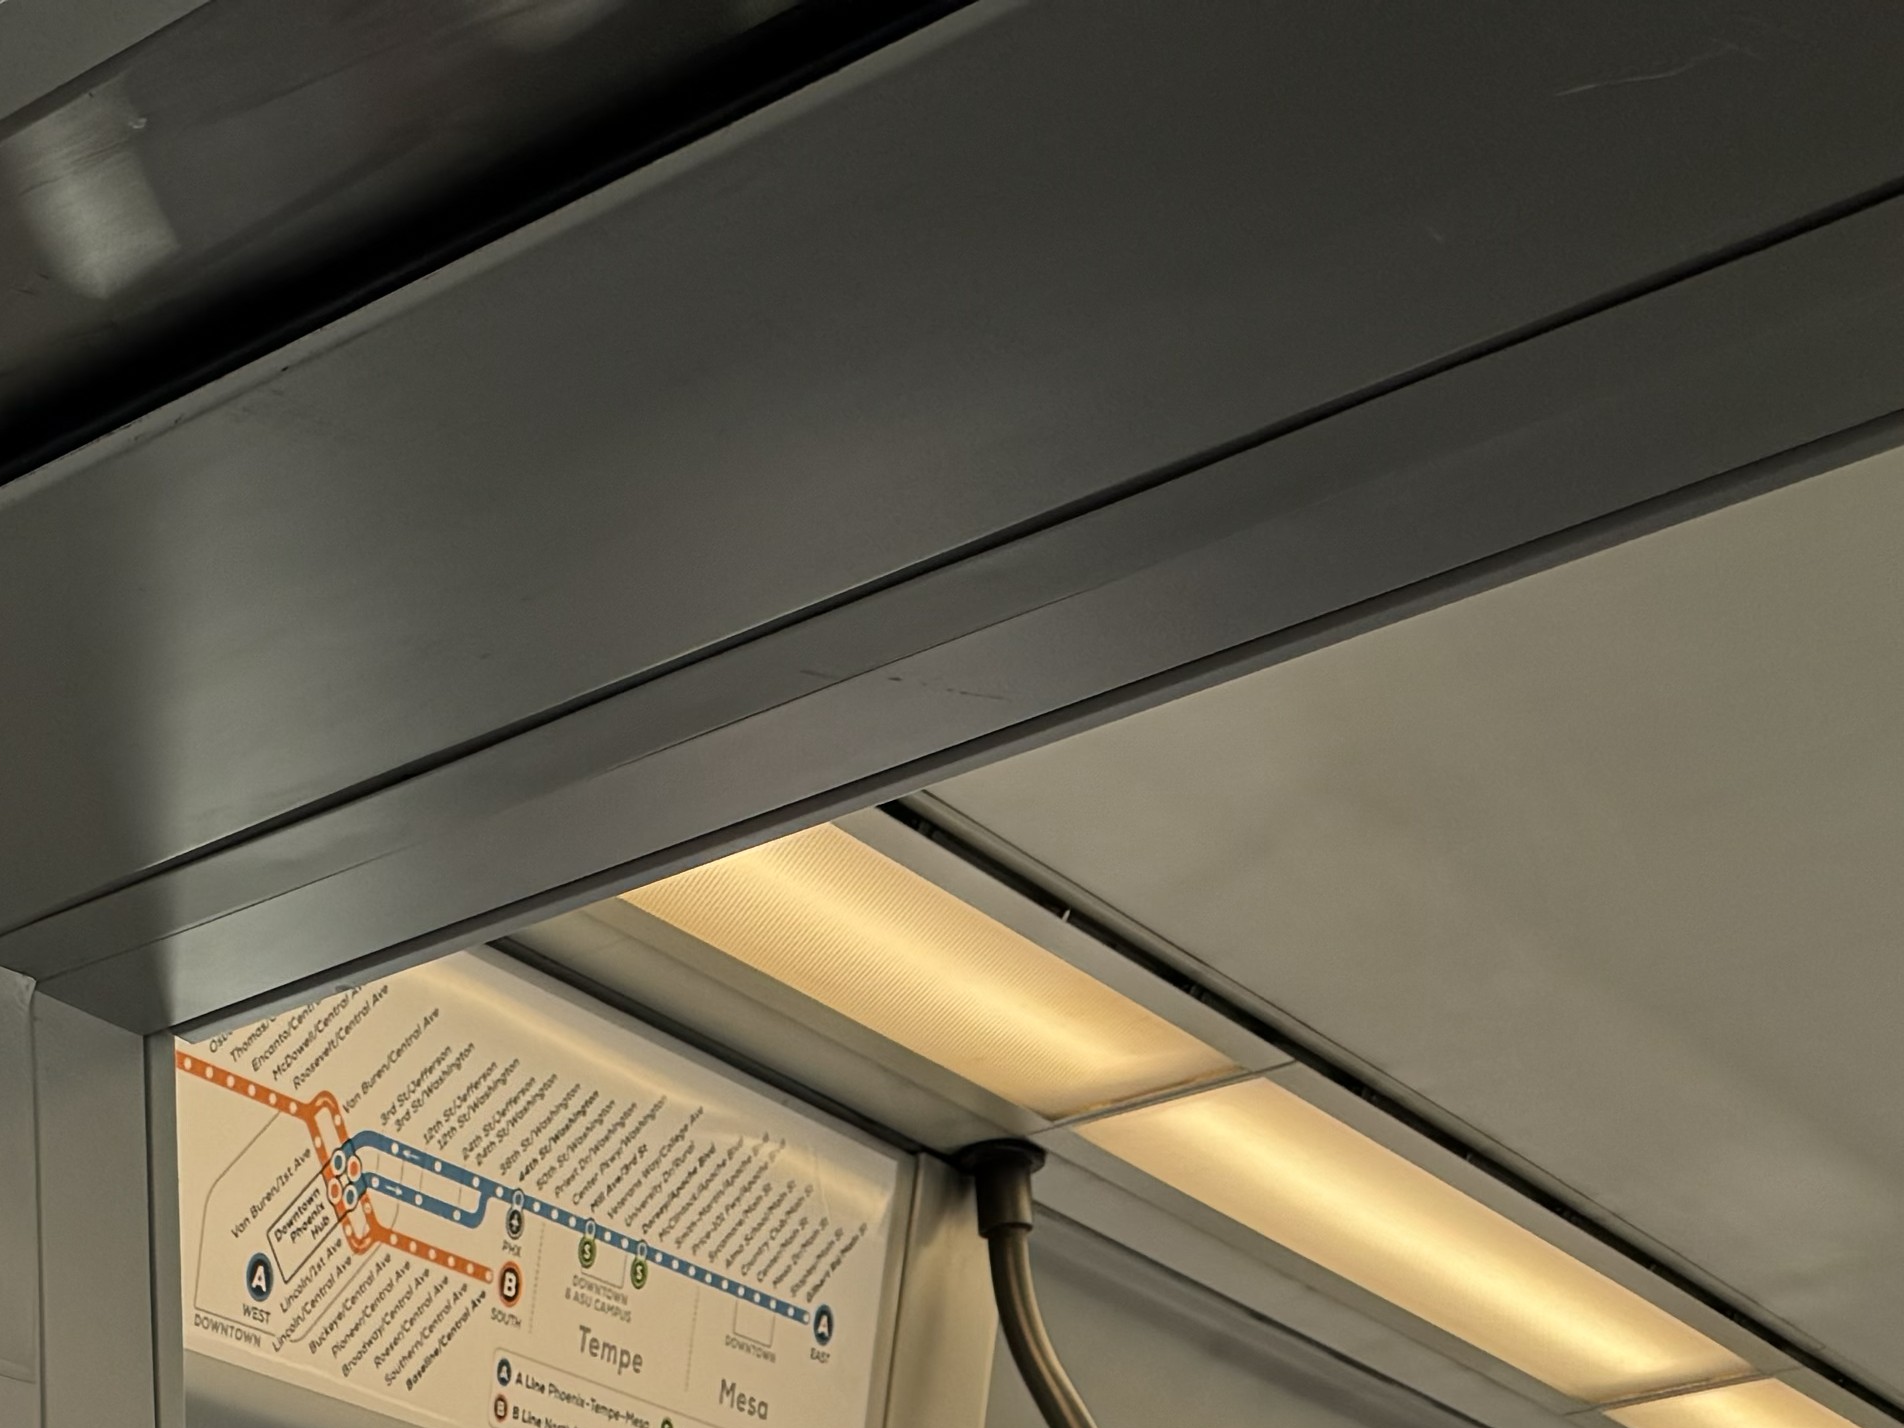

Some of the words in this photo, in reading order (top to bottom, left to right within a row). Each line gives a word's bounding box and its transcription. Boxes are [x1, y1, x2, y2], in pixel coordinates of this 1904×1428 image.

[371, 985, 389, 1008] Ave
[342, 1092, 362, 1114] Van
[422, 1008, 439, 1031] Ave
[380, 1102, 397, 1127] 3rd
[394, 1108, 412, 1133] 3rd
[231, 1216, 252, 1239] Van
[293, 1148, 311, 1172] Ave
[273, 1188, 321, 1243] Downtown
[290, 1202, 326, 1244] Phoenix
[310, 1215, 331, 1241] Hub
[327, 1238, 343, 1261] Ave
[336, 1255, 353, 1279] Ave
[375, 1253, 392, 1276] Ave
[395, 1260, 412, 1282] Ave
[252, 1264, 267, 1293] A
[414, 1268, 431, 1290] Ave
[433, 1275, 449, 1298] Ave
[503, 1269, 518, 1298] B
[452, 1282, 469, 1305] Ave
[470, 1290, 487, 1312] Ave
[242, 1303, 272, 1326] WEST
[490, 1308, 523, 1329] SOUTH
[194, 1313, 263, 1348] DOWNTOWN
[579, 1324, 644, 1376] Tempe
[514, 1371, 524, 1387] A
[718, 1378, 770, 1420] Mesa
[512, 1405, 520, 1420] B
